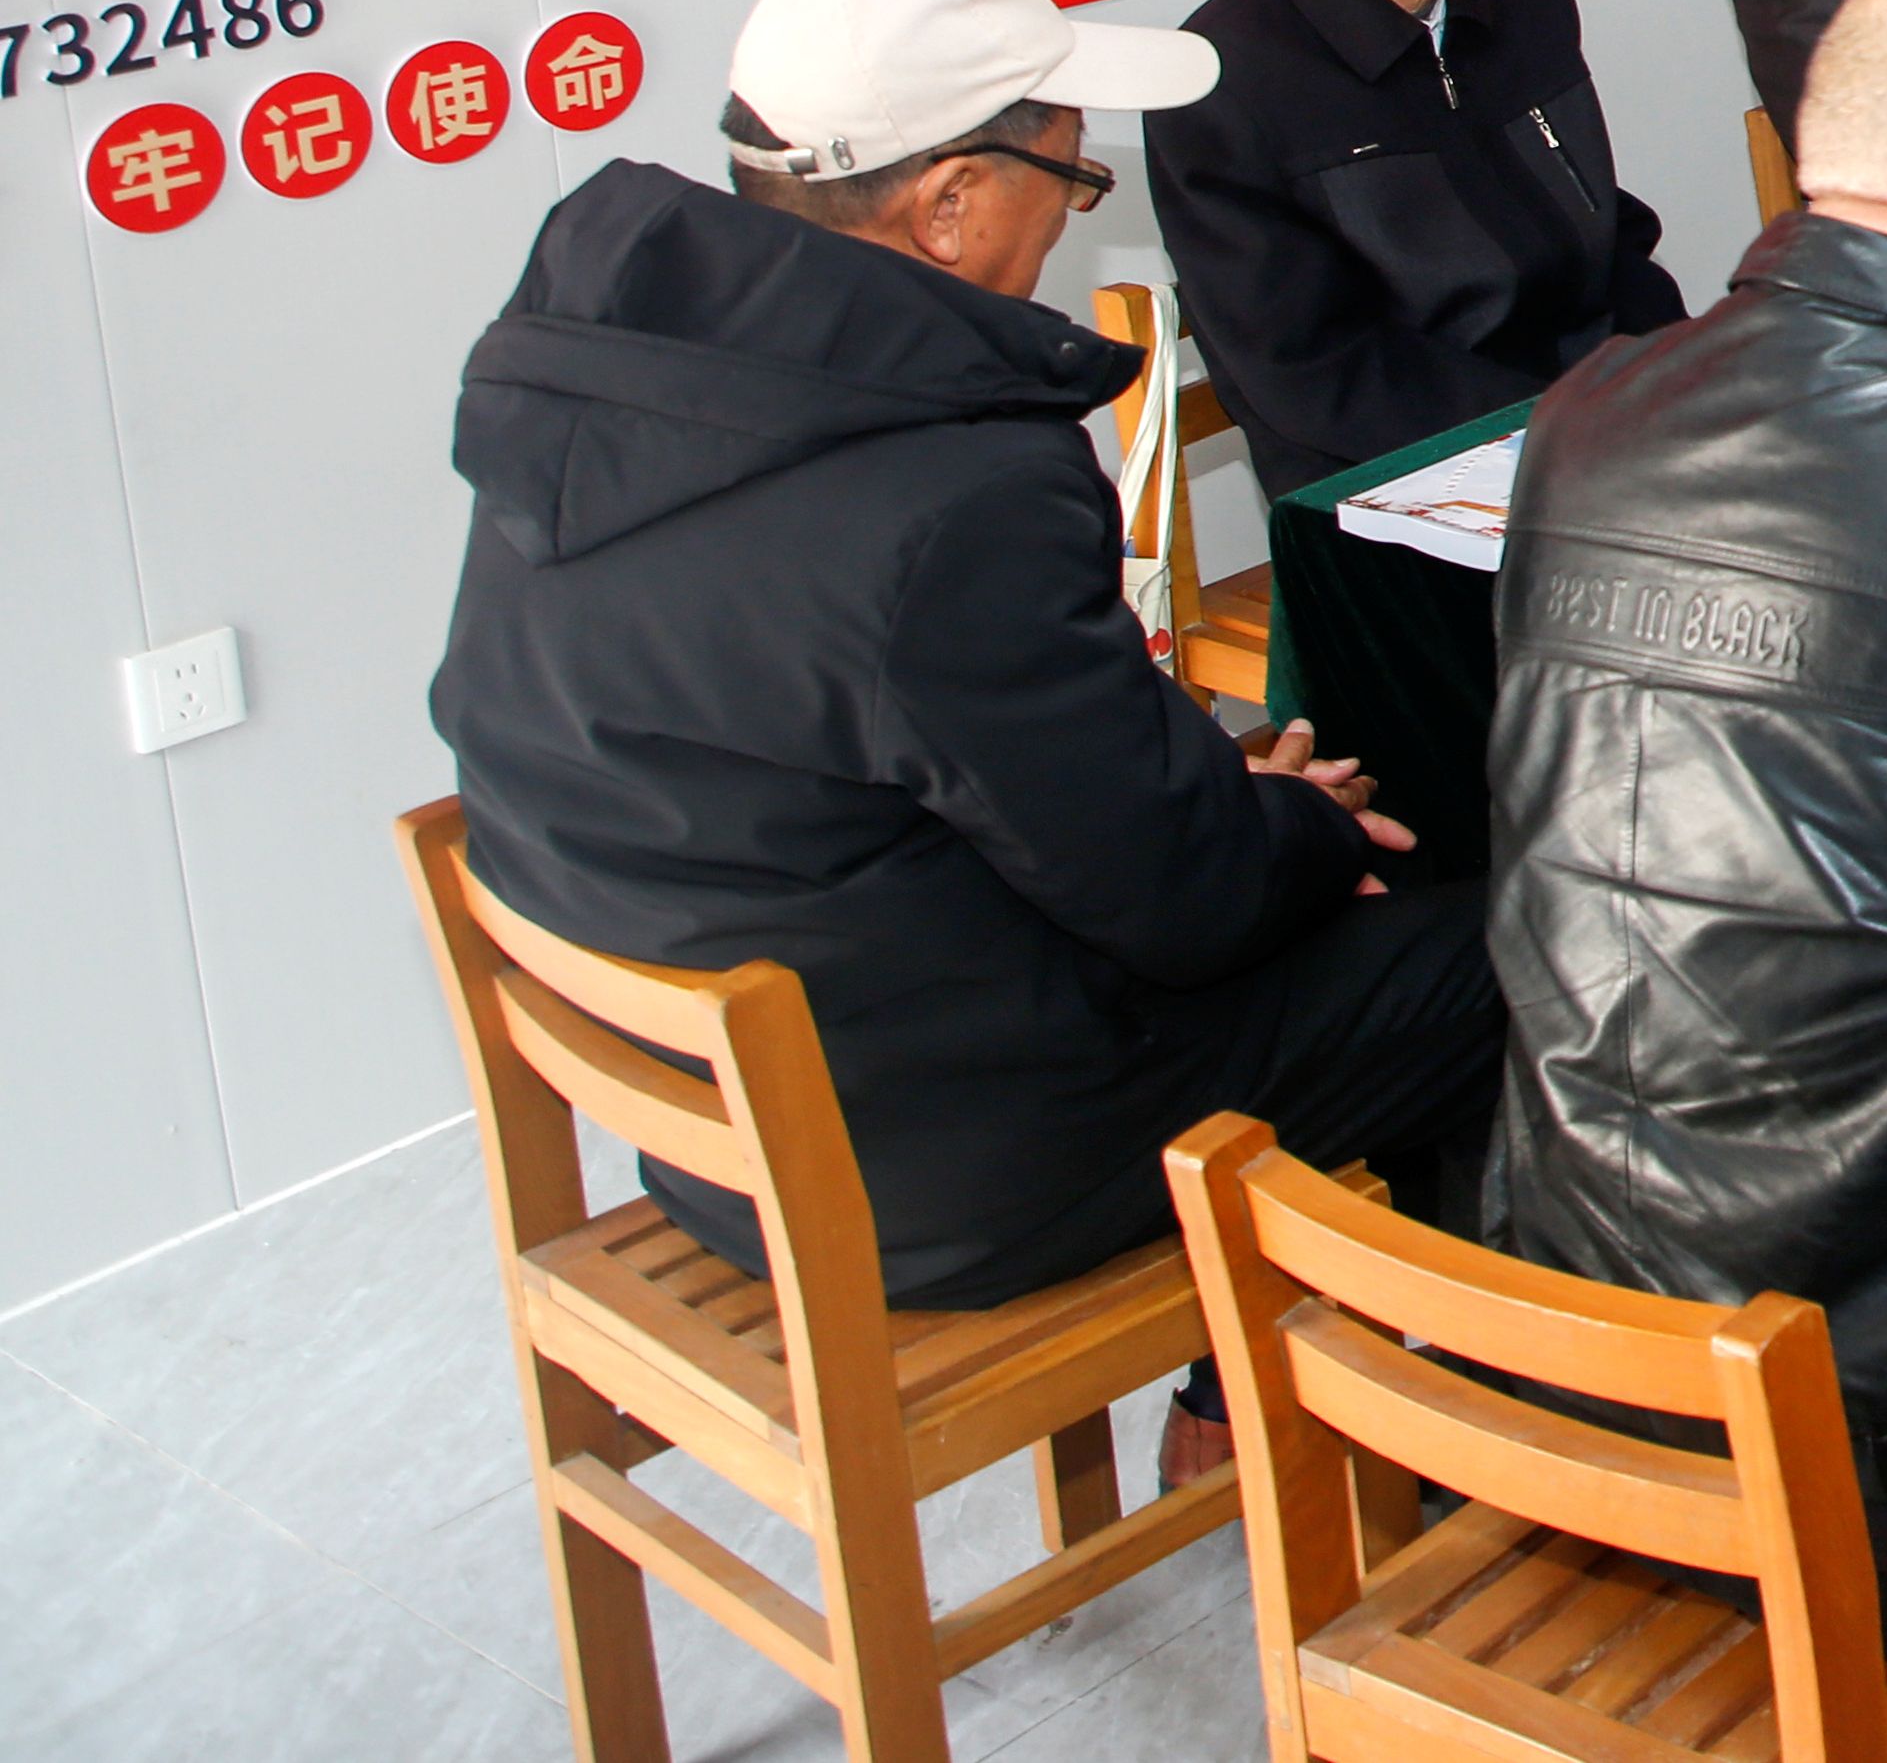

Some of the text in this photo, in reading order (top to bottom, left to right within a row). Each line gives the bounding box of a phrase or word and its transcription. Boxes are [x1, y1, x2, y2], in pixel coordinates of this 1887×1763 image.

[107, 32, 624, 212] 牢记使命
[1678, 593, 1814, 671] BLACK
